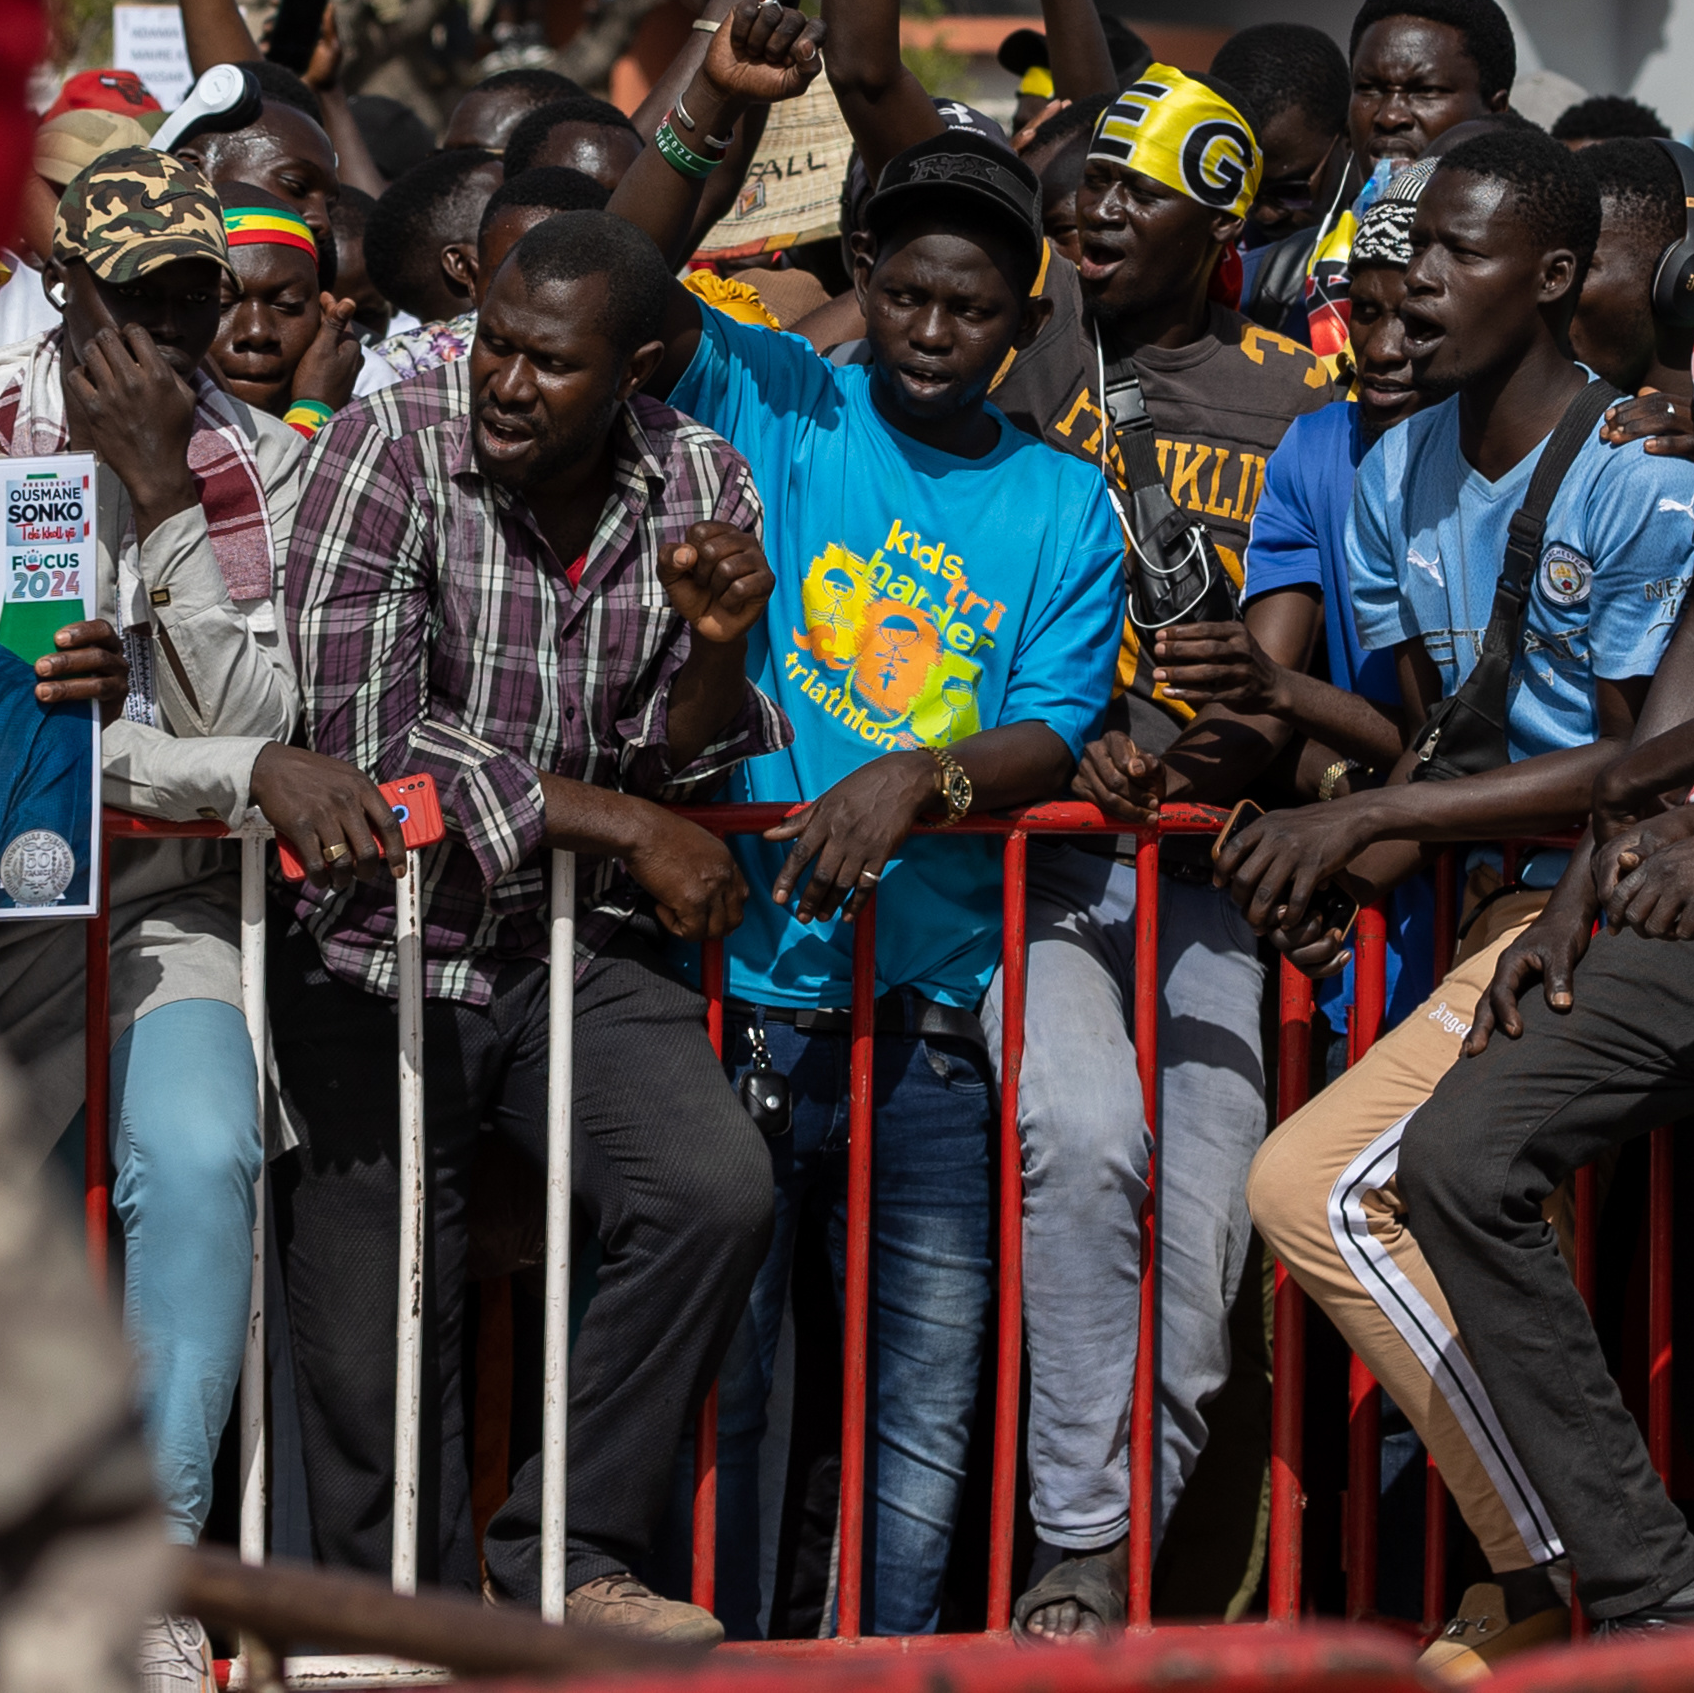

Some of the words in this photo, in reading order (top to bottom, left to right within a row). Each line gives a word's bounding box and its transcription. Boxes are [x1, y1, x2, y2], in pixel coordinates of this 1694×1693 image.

[666, 132, 693, 161] 2024
[747, 151, 827, 181] FALL
[10, 487, 81, 502] OUSMANE
[8, 502, 83, 523] SONKO
[12, 552, 79, 572] FOCUS
[1543, 549, 1586, 569] MANCHESTER
[11, 570, 80, 599] 2024
[884, 519, 964, 580] kids
[945, 575, 1007, 633] tri
[862, 549, 996, 657] harder
[1562, 593, 1581, 602] CITY
[785, 651, 898, 750] triathlon
[27, 852, 51, 869] 50
